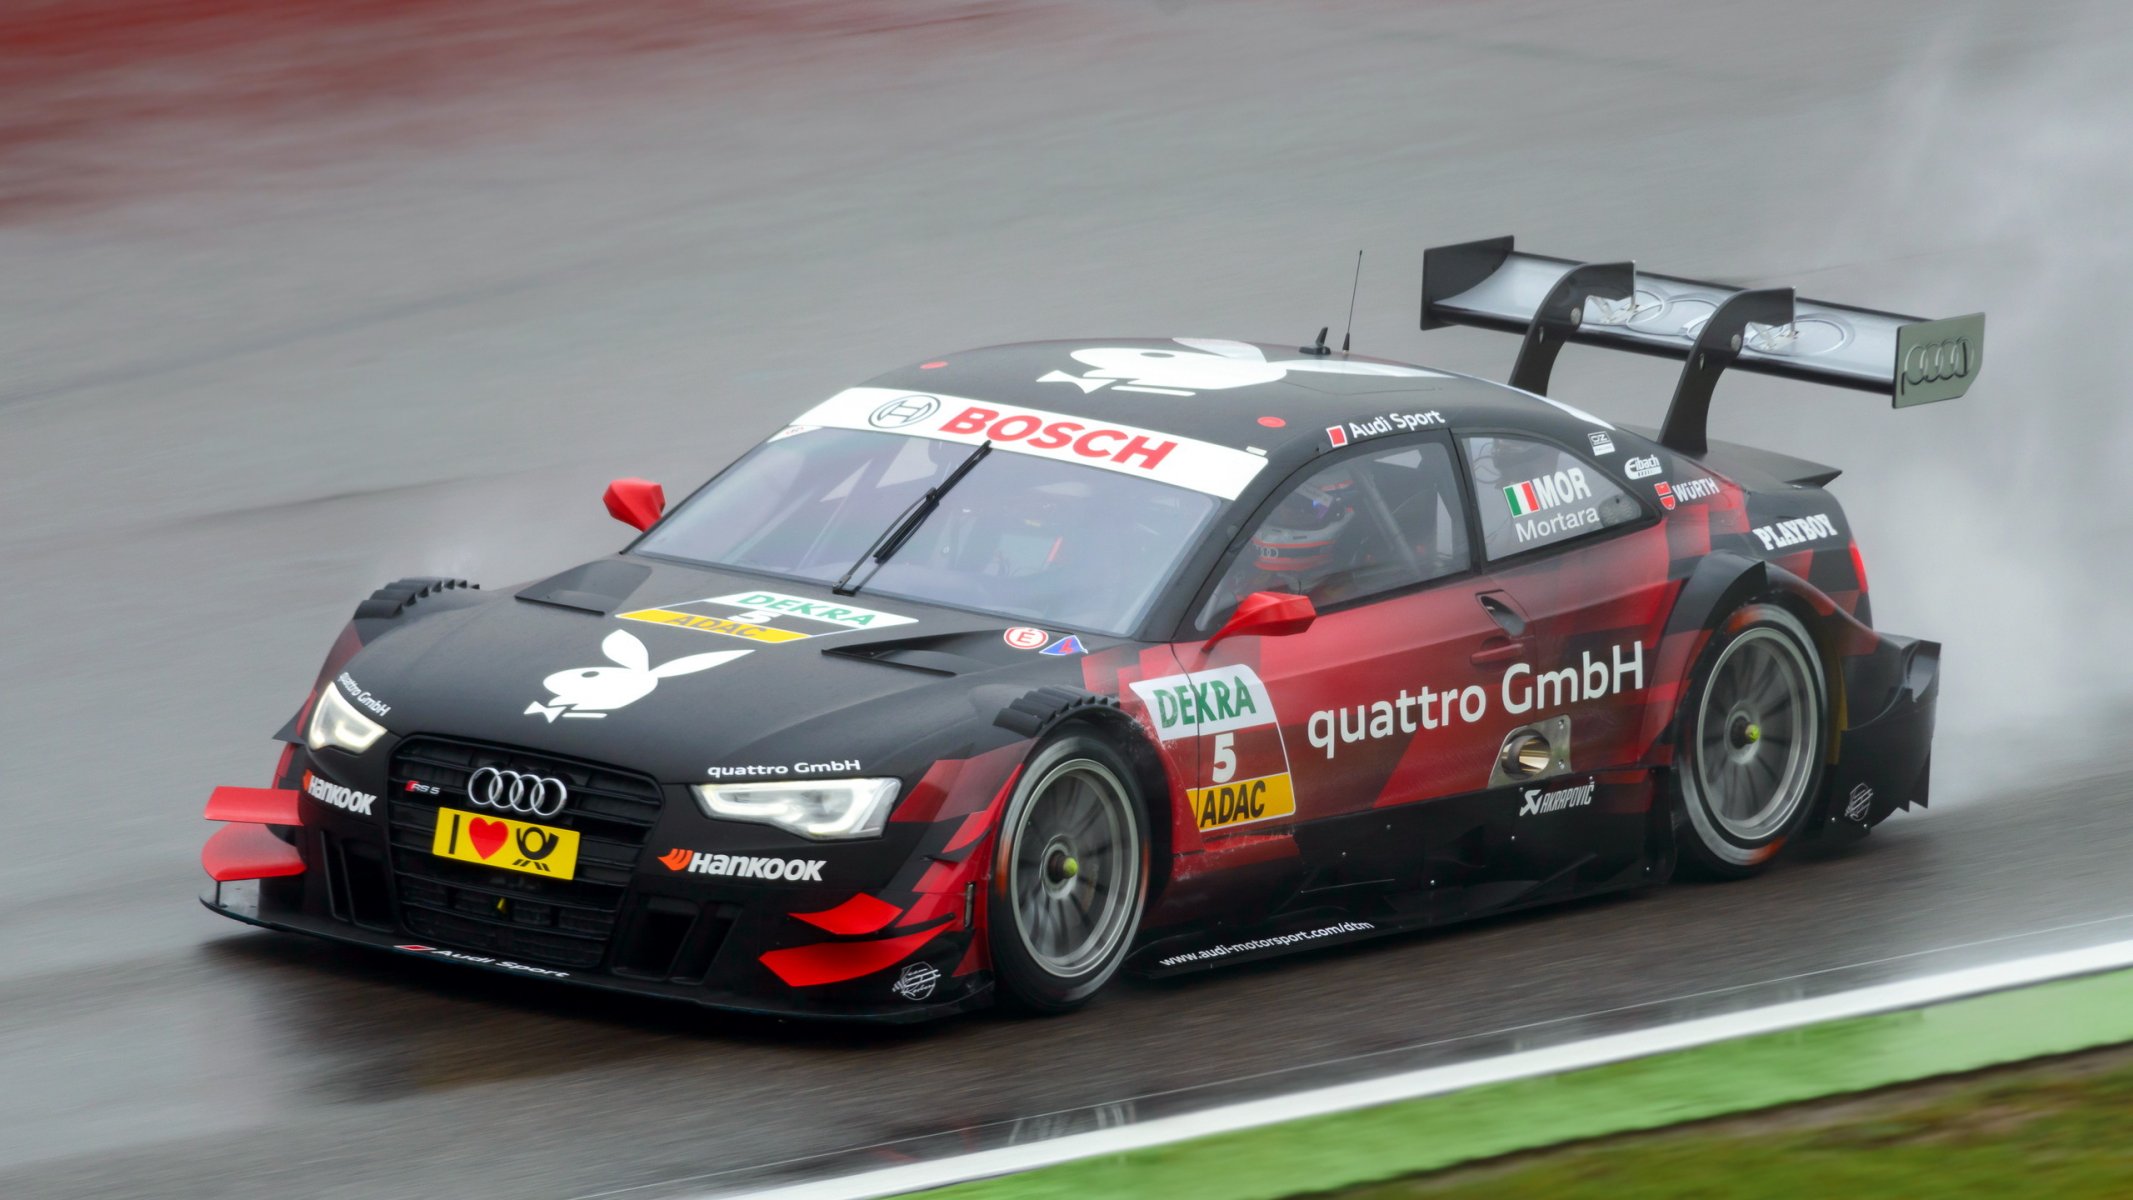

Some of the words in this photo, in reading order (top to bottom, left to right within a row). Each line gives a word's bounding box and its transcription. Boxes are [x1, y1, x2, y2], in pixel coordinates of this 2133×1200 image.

[938, 407, 1179, 470] BOSCH
[1348, 416, 1393, 438] Audi
[1389, 410, 1446, 431] Sport
[1624, 454, 1662, 480] Eibach
[1532, 467, 1592, 510] MOR
[1672, 477, 1720, 502] WÜRTH
[1515, 507, 1600, 543] Mortara
[1752, 513, 1838, 551] PLAYBOY
[668, 615, 767, 637] ADAC
[727, 610, 783, 624] 5
[737, 594, 876, 626] DEKRA
[357, 691, 391, 716] GmbH
[1153, 676, 1256, 729] DEKRA
[1307, 684, 1487, 759] quattro
[1501, 641, 1644, 714] GmbH
[708, 765, 788, 778] quattro
[794, 759, 861, 773] GmbH
[1212, 732, 1237, 783] 5
[1200, 780, 1266, 828] ADAC
[1159, 921, 1375, 966] www.audi-motorsport.com/dtm
[432, 951, 496, 963] Audi
[496, 961, 570, 977] Sport
